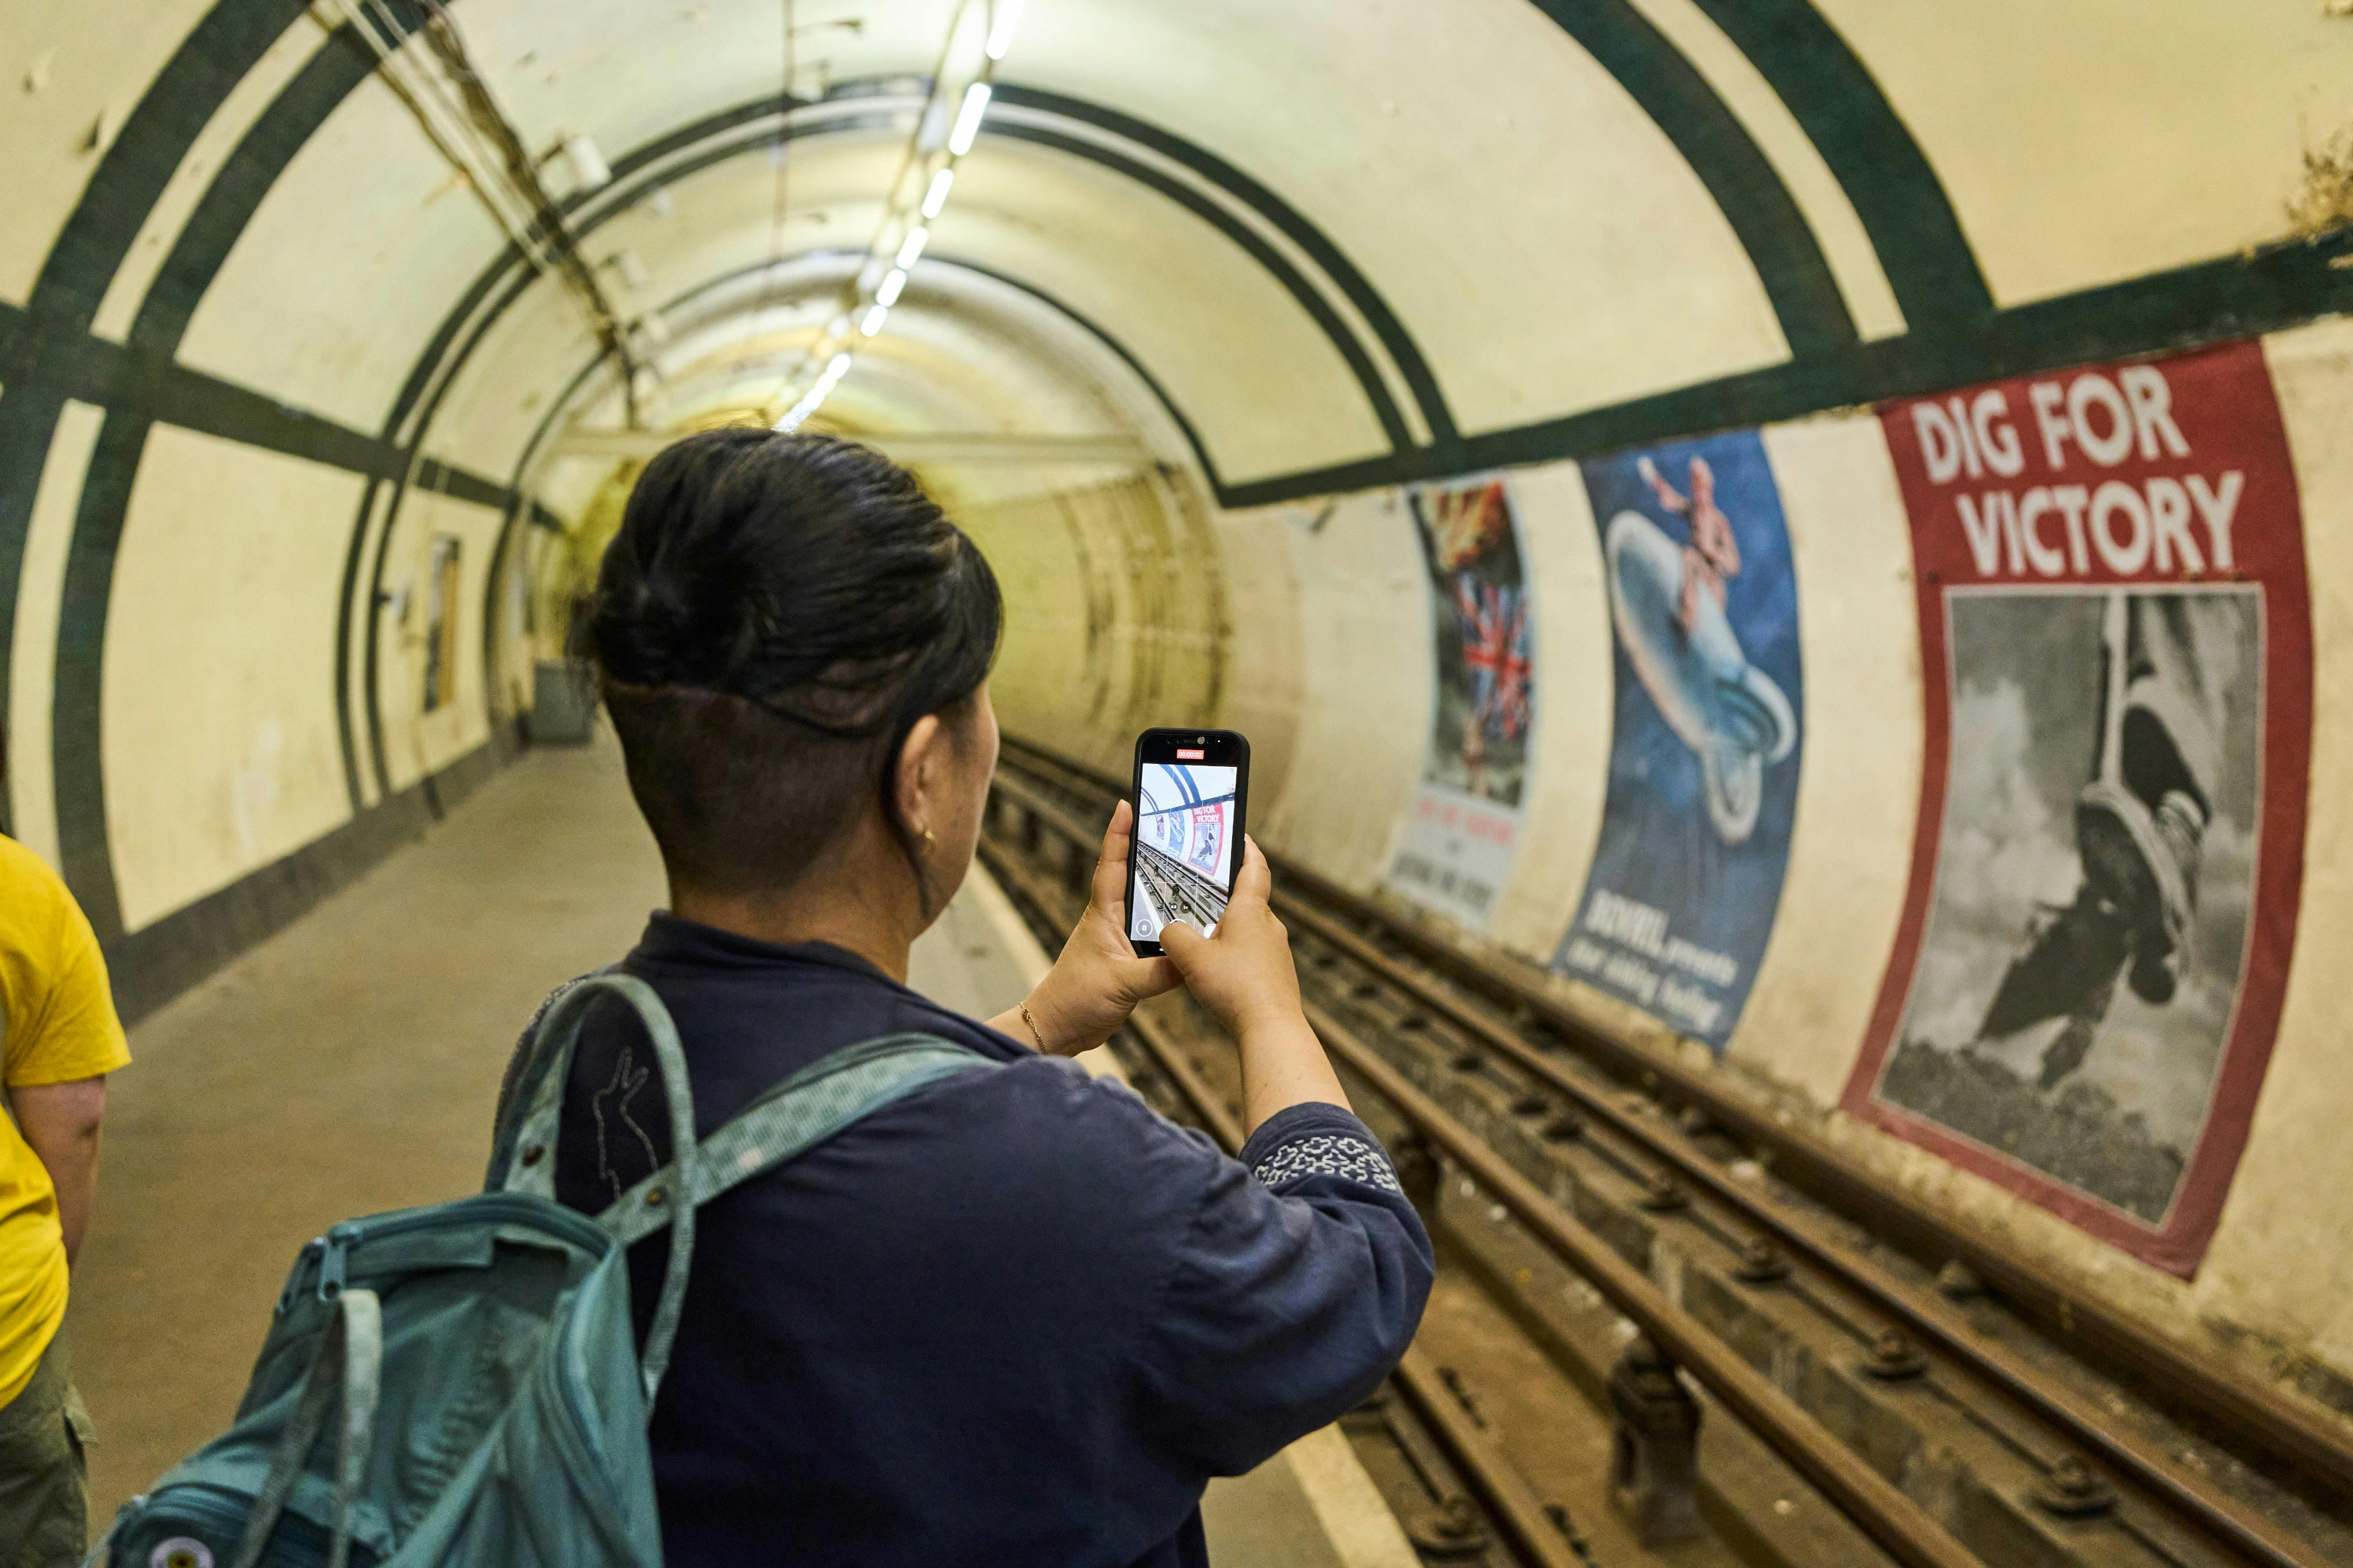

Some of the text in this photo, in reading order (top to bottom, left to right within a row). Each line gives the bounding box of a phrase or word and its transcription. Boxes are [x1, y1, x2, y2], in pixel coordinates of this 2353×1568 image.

[1911, 365, 2191, 484] DIG FOR
[1957, 470, 2245, 576] VICTORY
[1197, 814, 1220, 822] VICTORY
[1203, 805, 1215, 814] FOR
